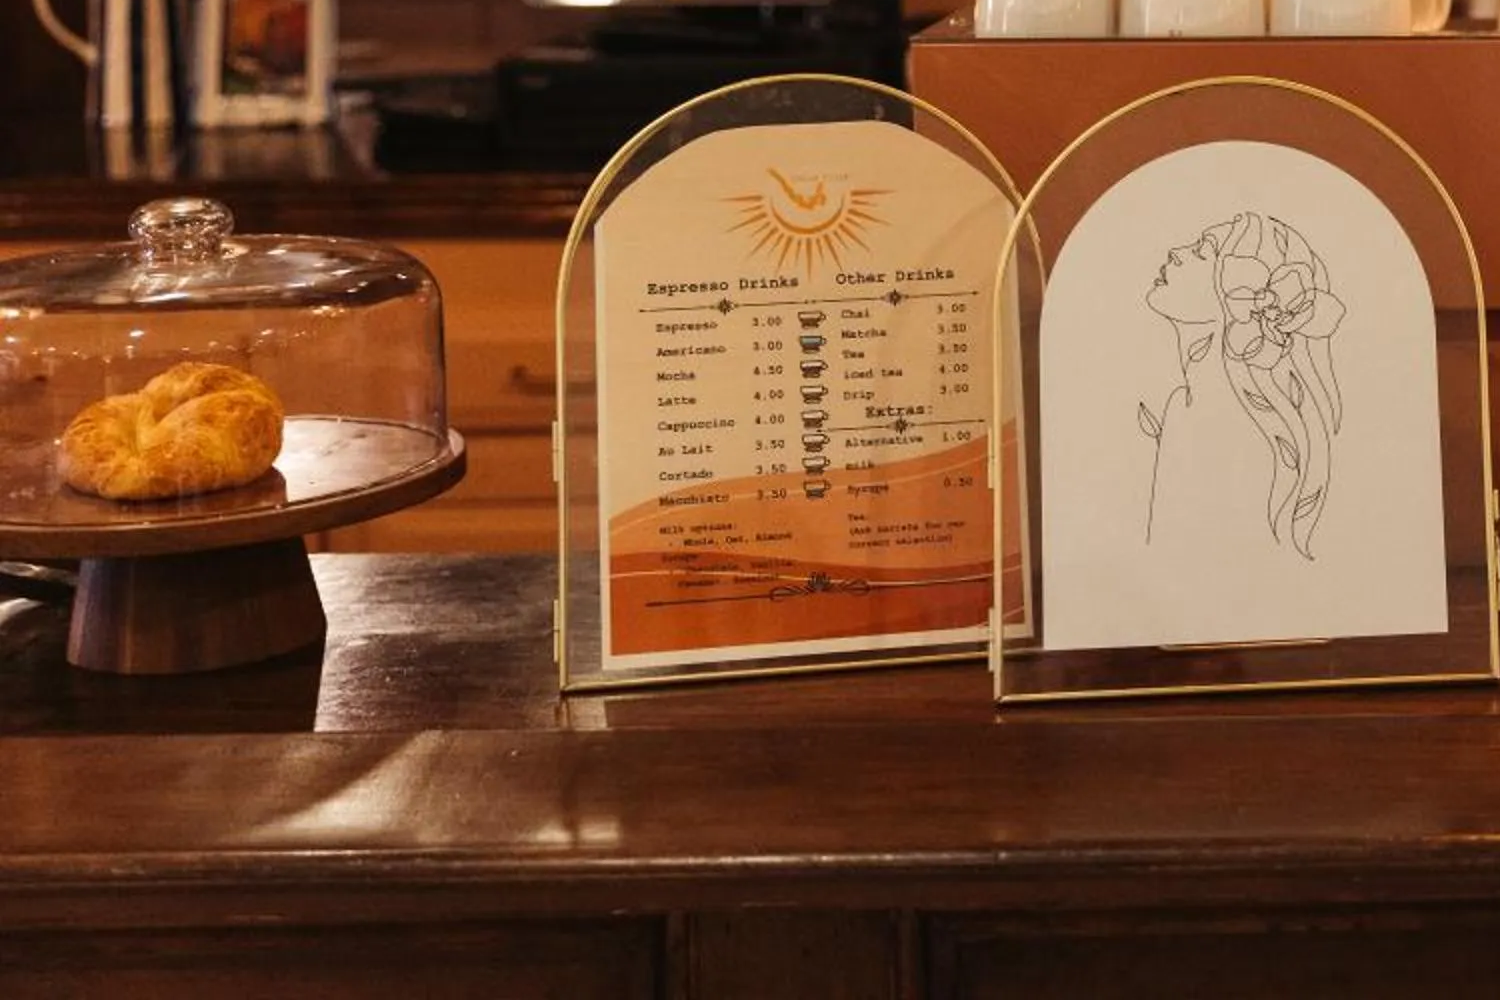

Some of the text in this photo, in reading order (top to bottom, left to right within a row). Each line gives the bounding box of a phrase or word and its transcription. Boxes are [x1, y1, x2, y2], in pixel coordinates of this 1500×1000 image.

[835, 267, 955, 285] Other Drinks
[647, 275, 799, 297] Espresso Drinks
[841, 308, 870, 319] Chai
[656, 316, 782, 334] Espresso 3.00
[841, 328, 887, 339] Matcha
[656, 341, 783, 357] Americano 3.00
[841, 350, 865, 360] Tea
[656, 365, 784, 382] Mocha 4.50
[881, 367, 903, 377] tea
[657, 389, 785, 407] Latte 4.00
[843, 390, 875, 401] Drip
[865, 404, 934, 418] Extras:
[657, 413, 785, 433] Cappuccino 4.00
[658, 439, 785, 457] Au Lait 3.50
[845, 435, 924, 448] Alternative
[659, 463, 787, 481] Cortado 3.50
[658, 494, 730, 507] Macchiato
